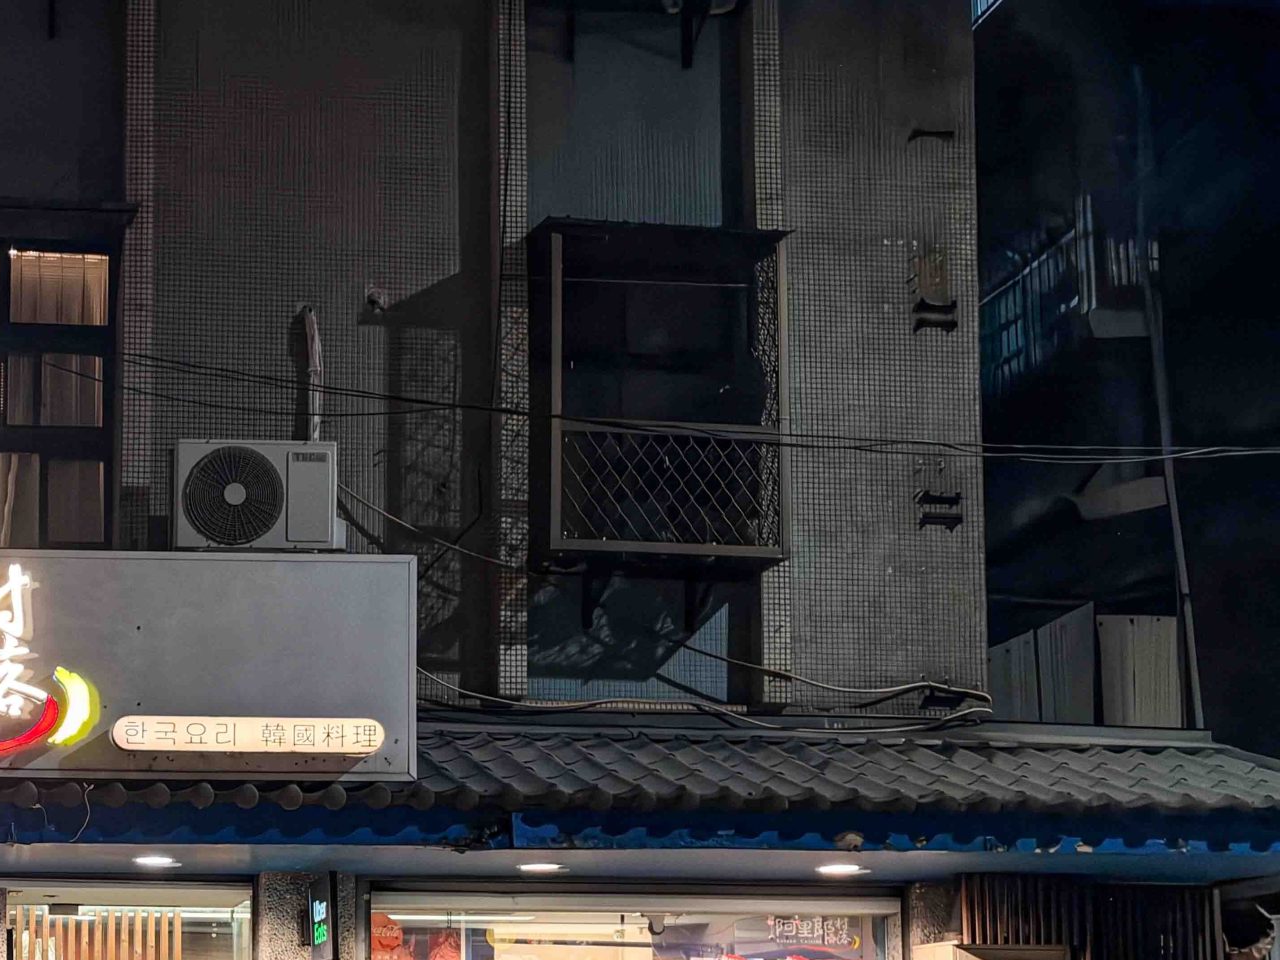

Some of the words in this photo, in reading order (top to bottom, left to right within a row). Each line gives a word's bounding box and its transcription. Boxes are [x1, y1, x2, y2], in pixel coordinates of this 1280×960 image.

[123, 721, 237, 746] 한국요리
[260, 723, 378, 748] 韓國料理
[313, 900, 327, 922] Uber
[315, 922, 327, 945] Eats
